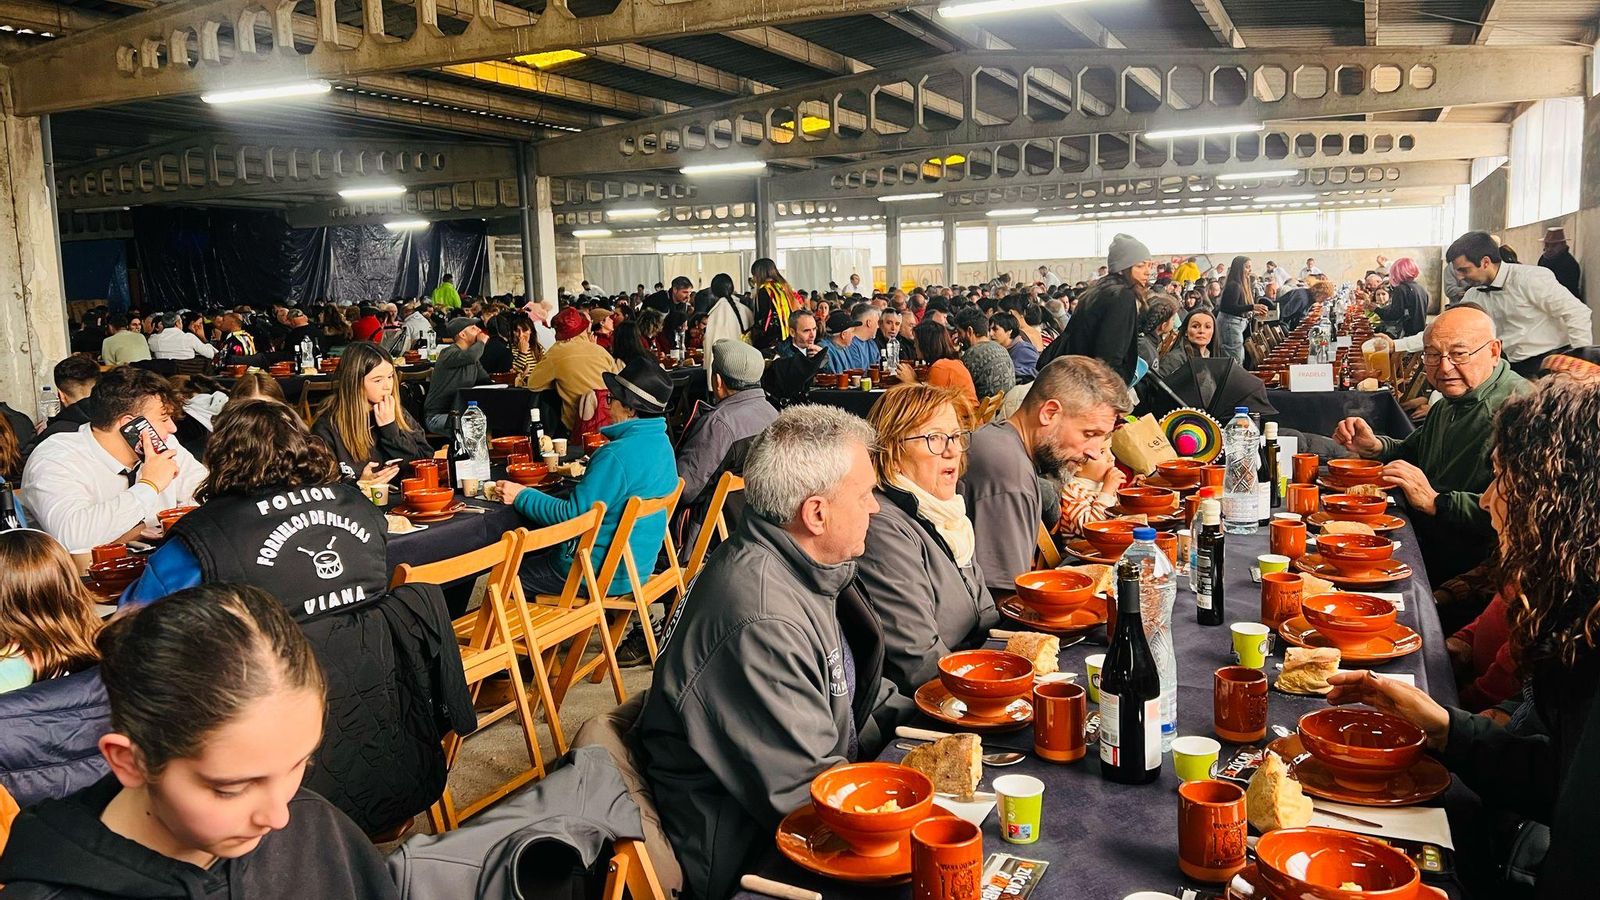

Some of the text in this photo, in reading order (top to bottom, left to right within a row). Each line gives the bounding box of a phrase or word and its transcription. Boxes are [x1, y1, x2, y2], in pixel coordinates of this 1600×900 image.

[256, 487, 336, 516] FOLION
[256, 509, 371, 567] FORNELOS DE FILLOAS
[304, 585, 366, 615] VIANA
